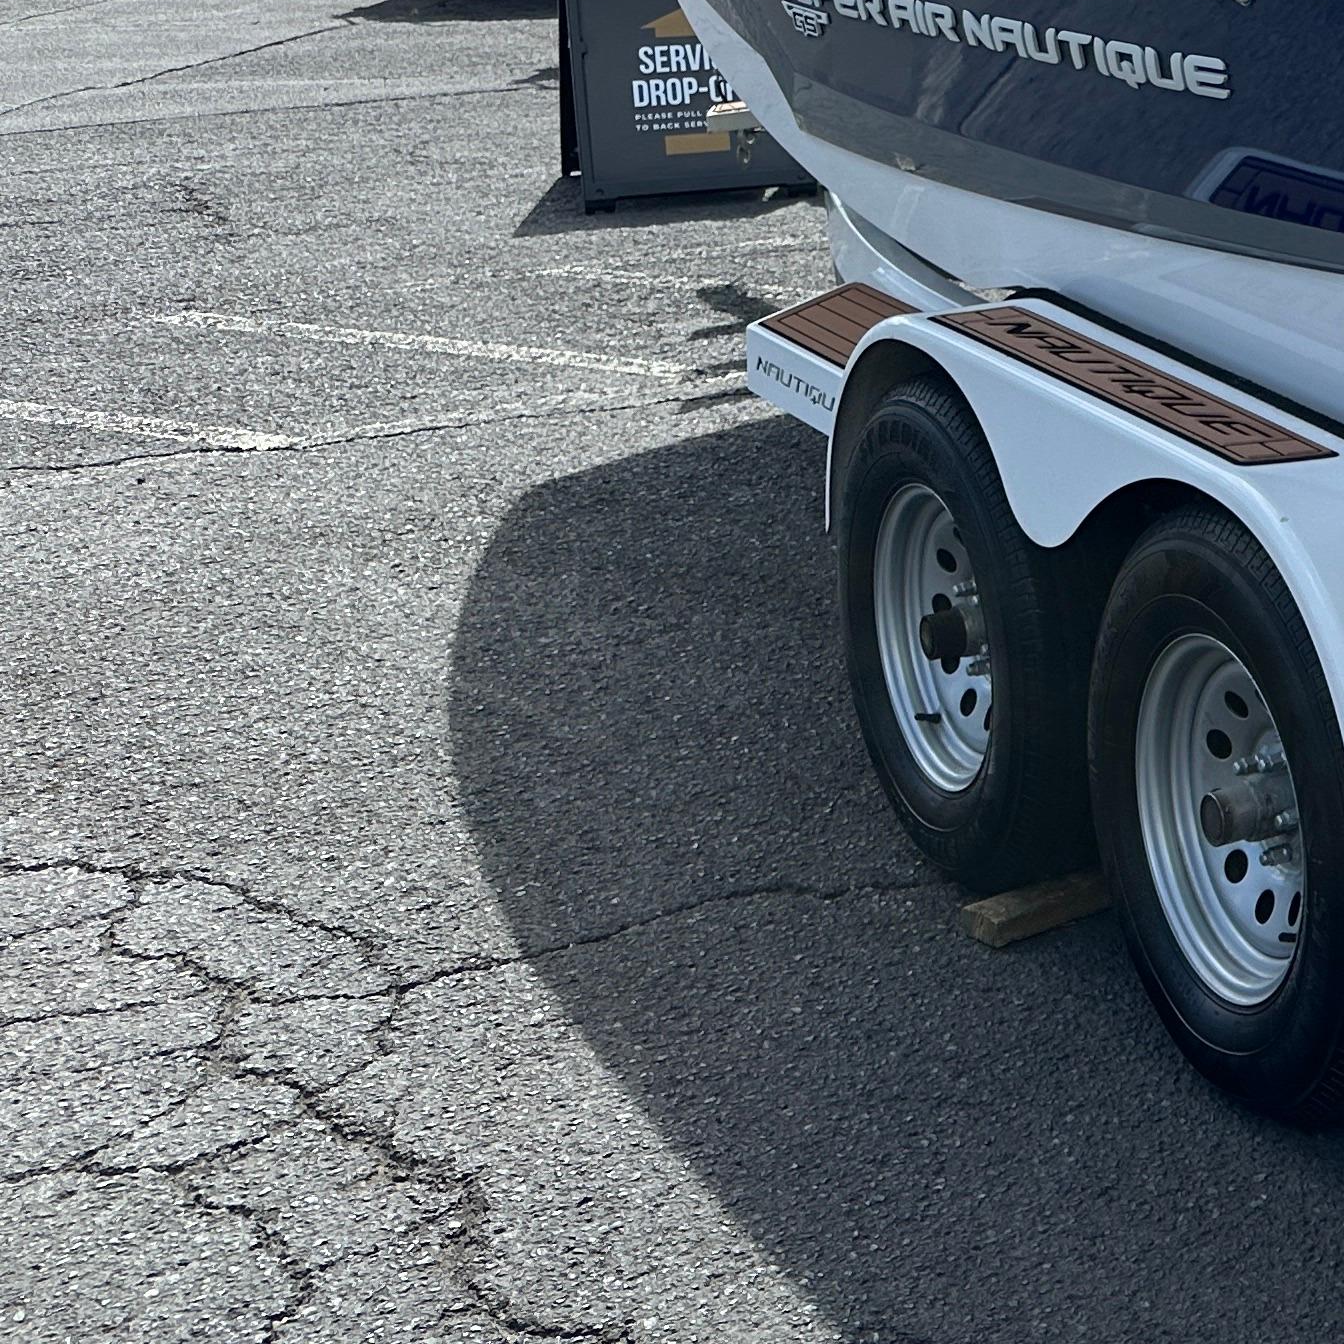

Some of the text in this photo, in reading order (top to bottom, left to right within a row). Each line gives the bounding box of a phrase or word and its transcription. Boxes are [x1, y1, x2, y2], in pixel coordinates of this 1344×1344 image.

[638, 43, 718, 75] SERVI
[962, 8, 1232, 100] NAUTIQUE
[632, 74, 735, 108] DROP-O
[634, 110, 703, 121] PLEASE PULL
[635, 124, 649, 132] TO
[652, 121, 681, 131] BACK
[756, 355, 836, 413] NAUTIQU
[985, 321, 1273, 438] NAUTIQUE
